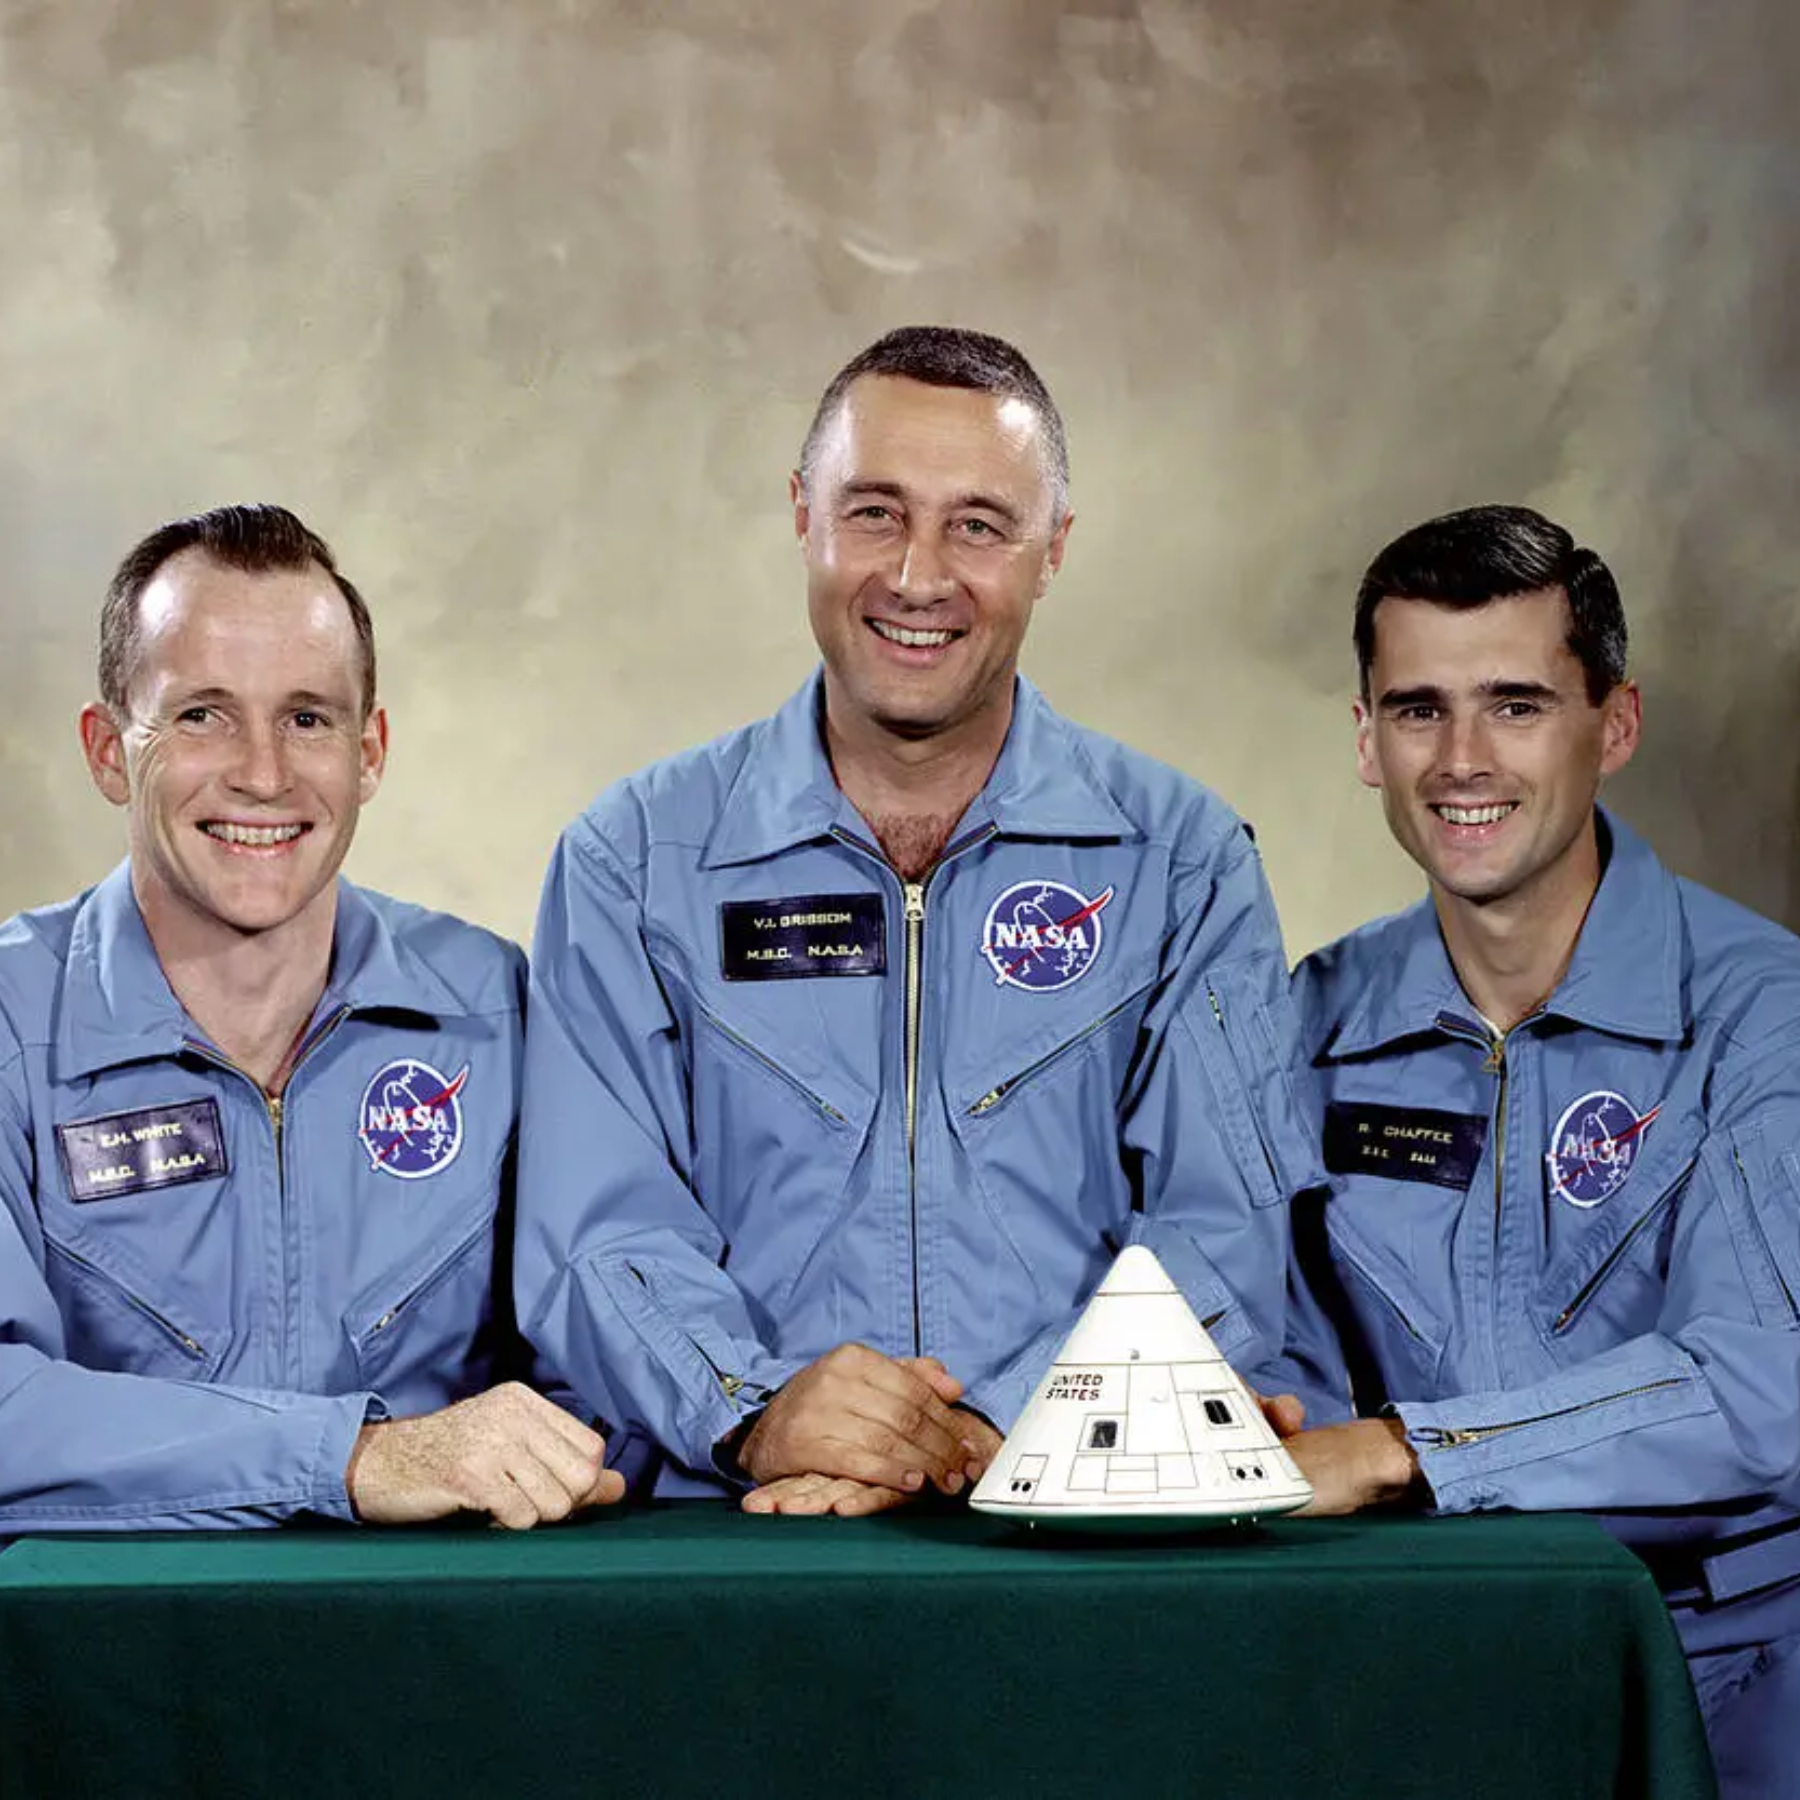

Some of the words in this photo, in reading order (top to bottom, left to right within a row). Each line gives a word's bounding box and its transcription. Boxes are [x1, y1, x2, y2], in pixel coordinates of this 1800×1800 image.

[780, 912, 852, 927] GRISSOM
[994, 922, 1090, 949] NASA
[368, 1106, 452, 1131] NASA
[133, 1122, 183, 1141] WHITE
[1383, 1125, 1453, 1144] CHAFFEE
[1052, 1373, 1104, 1386] UNITED
[1046, 1388, 1100, 1401] STATES
